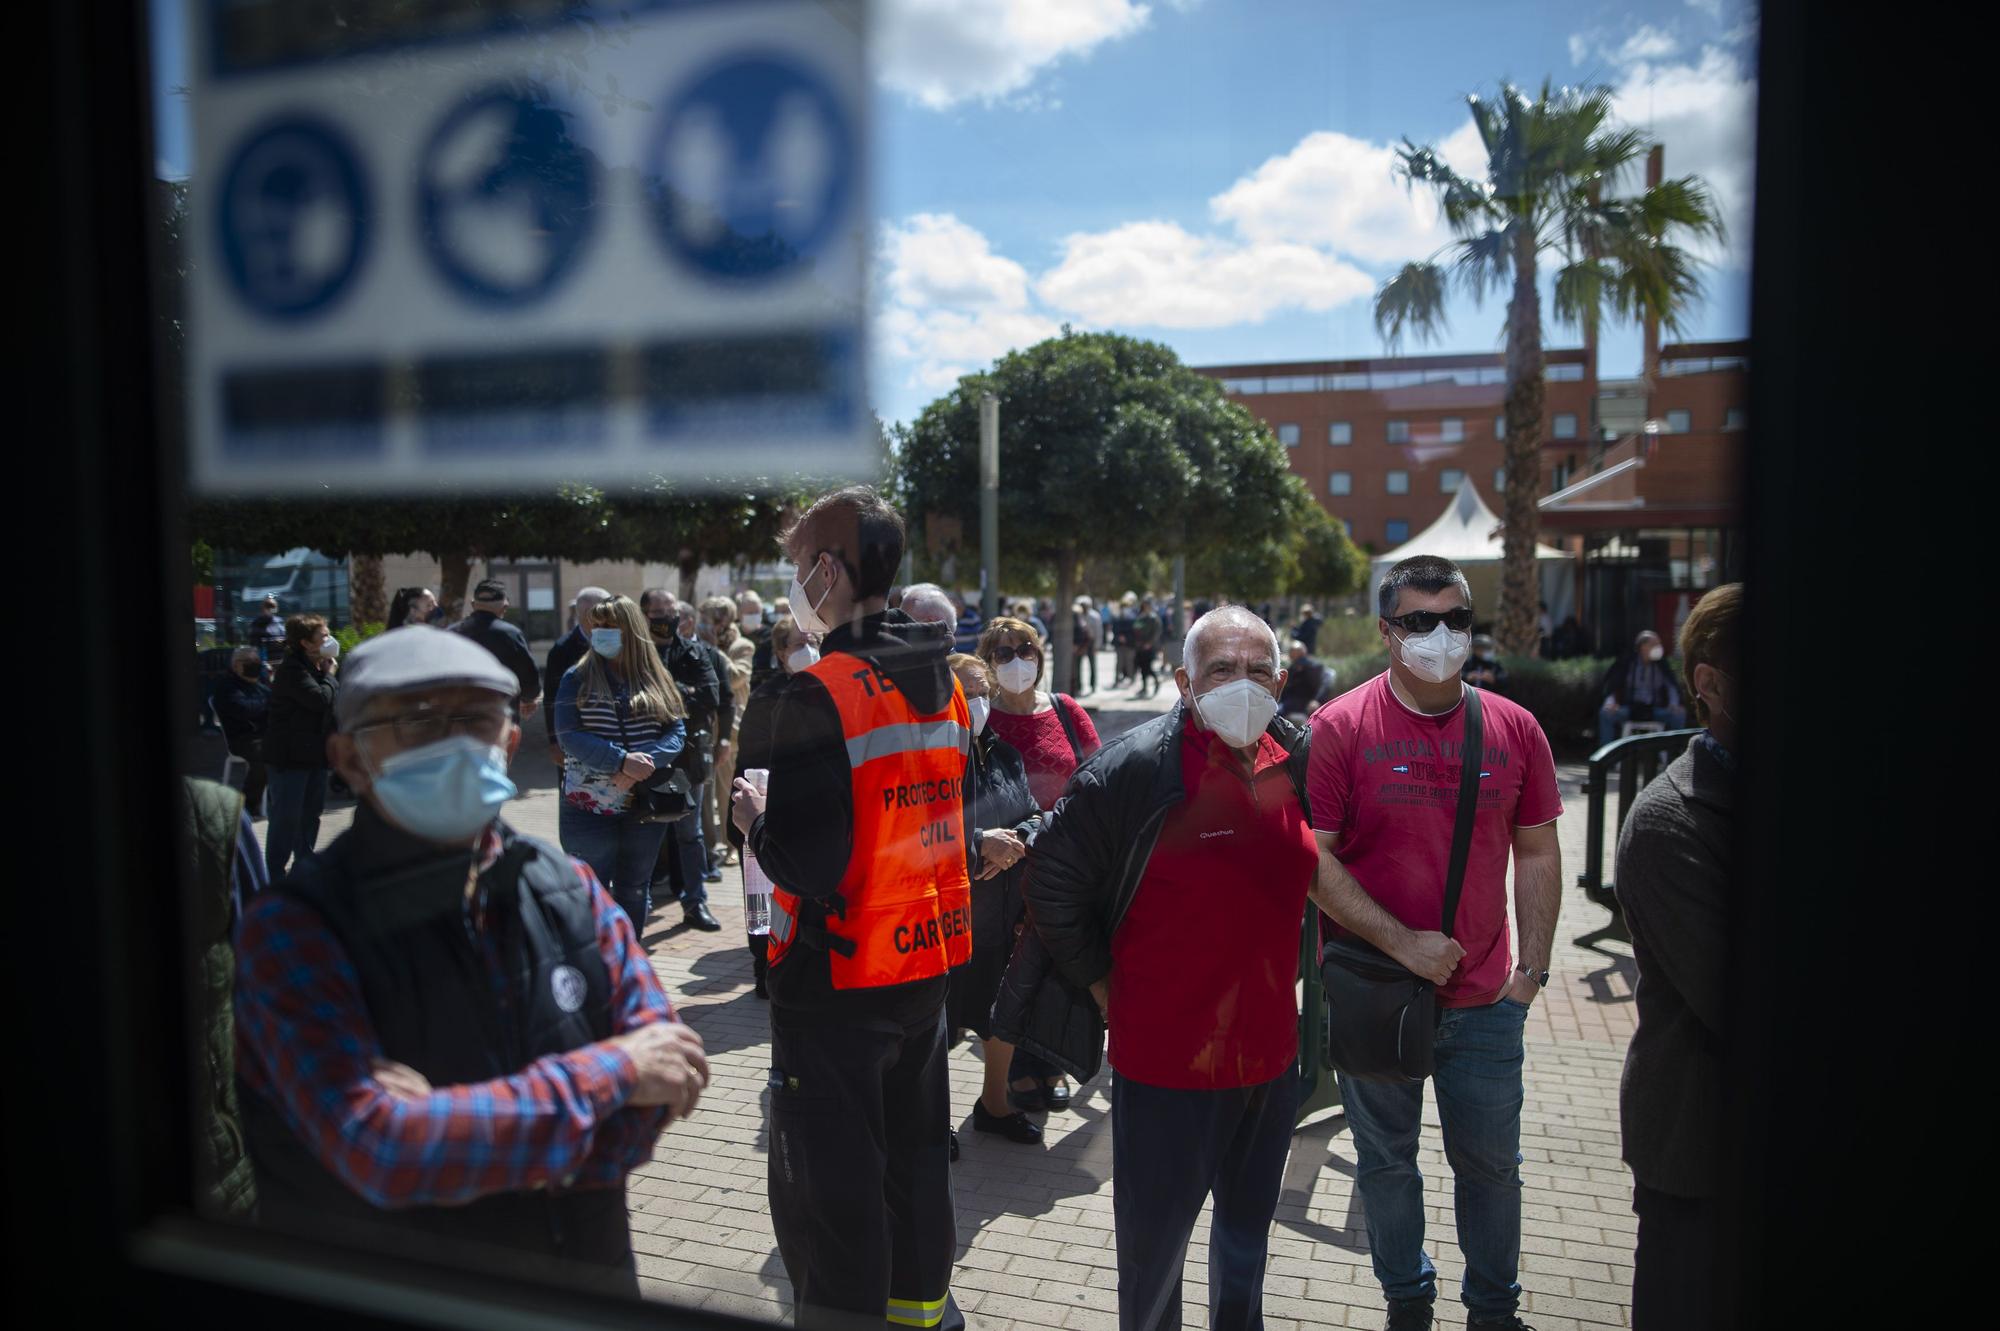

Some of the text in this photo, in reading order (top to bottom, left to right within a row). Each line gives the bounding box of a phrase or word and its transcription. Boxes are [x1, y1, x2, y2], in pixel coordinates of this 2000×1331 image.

[1365, 740, 1509, 768] NAUTICAL DIVION
[1381, 784, 1426, 795] AUTHENTIC
